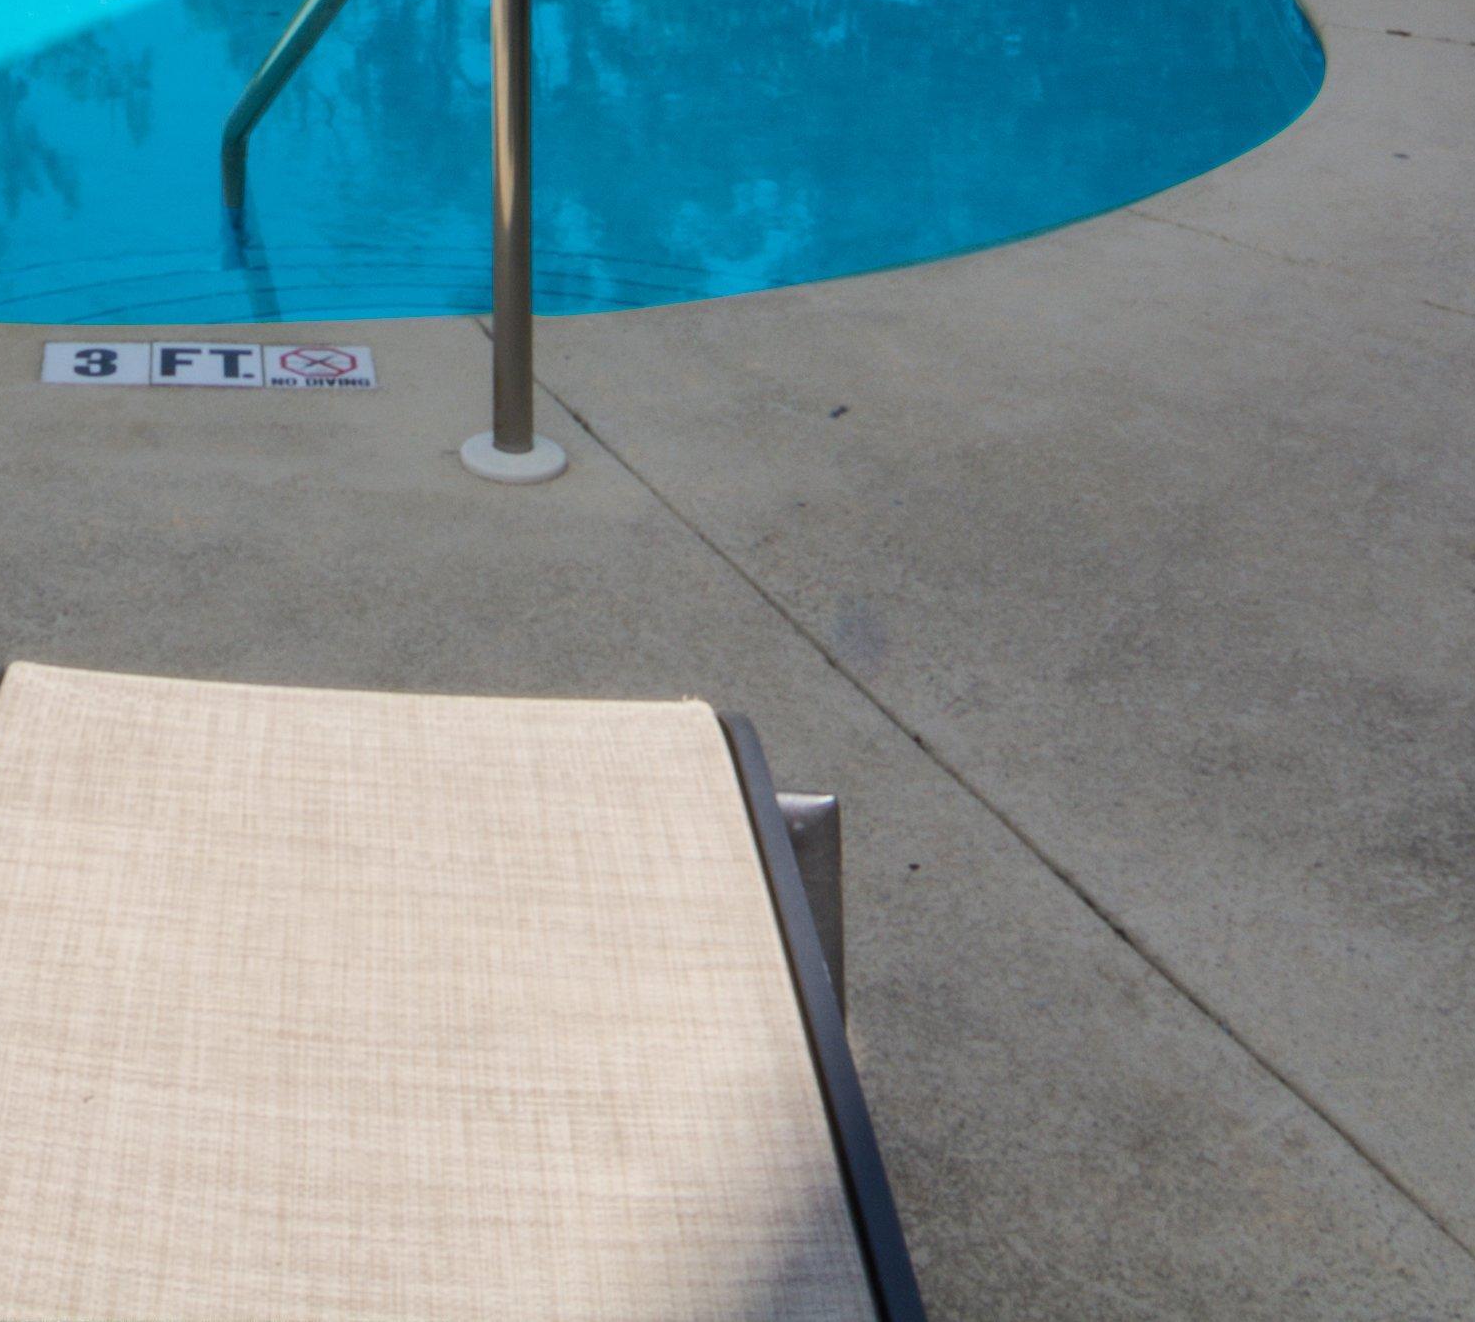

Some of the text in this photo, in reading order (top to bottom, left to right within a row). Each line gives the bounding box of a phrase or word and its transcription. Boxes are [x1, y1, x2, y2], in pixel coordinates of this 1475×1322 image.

[73, 347, 256, 379] 3 FT.
[271, 377, 371, 387] NO DIVING
